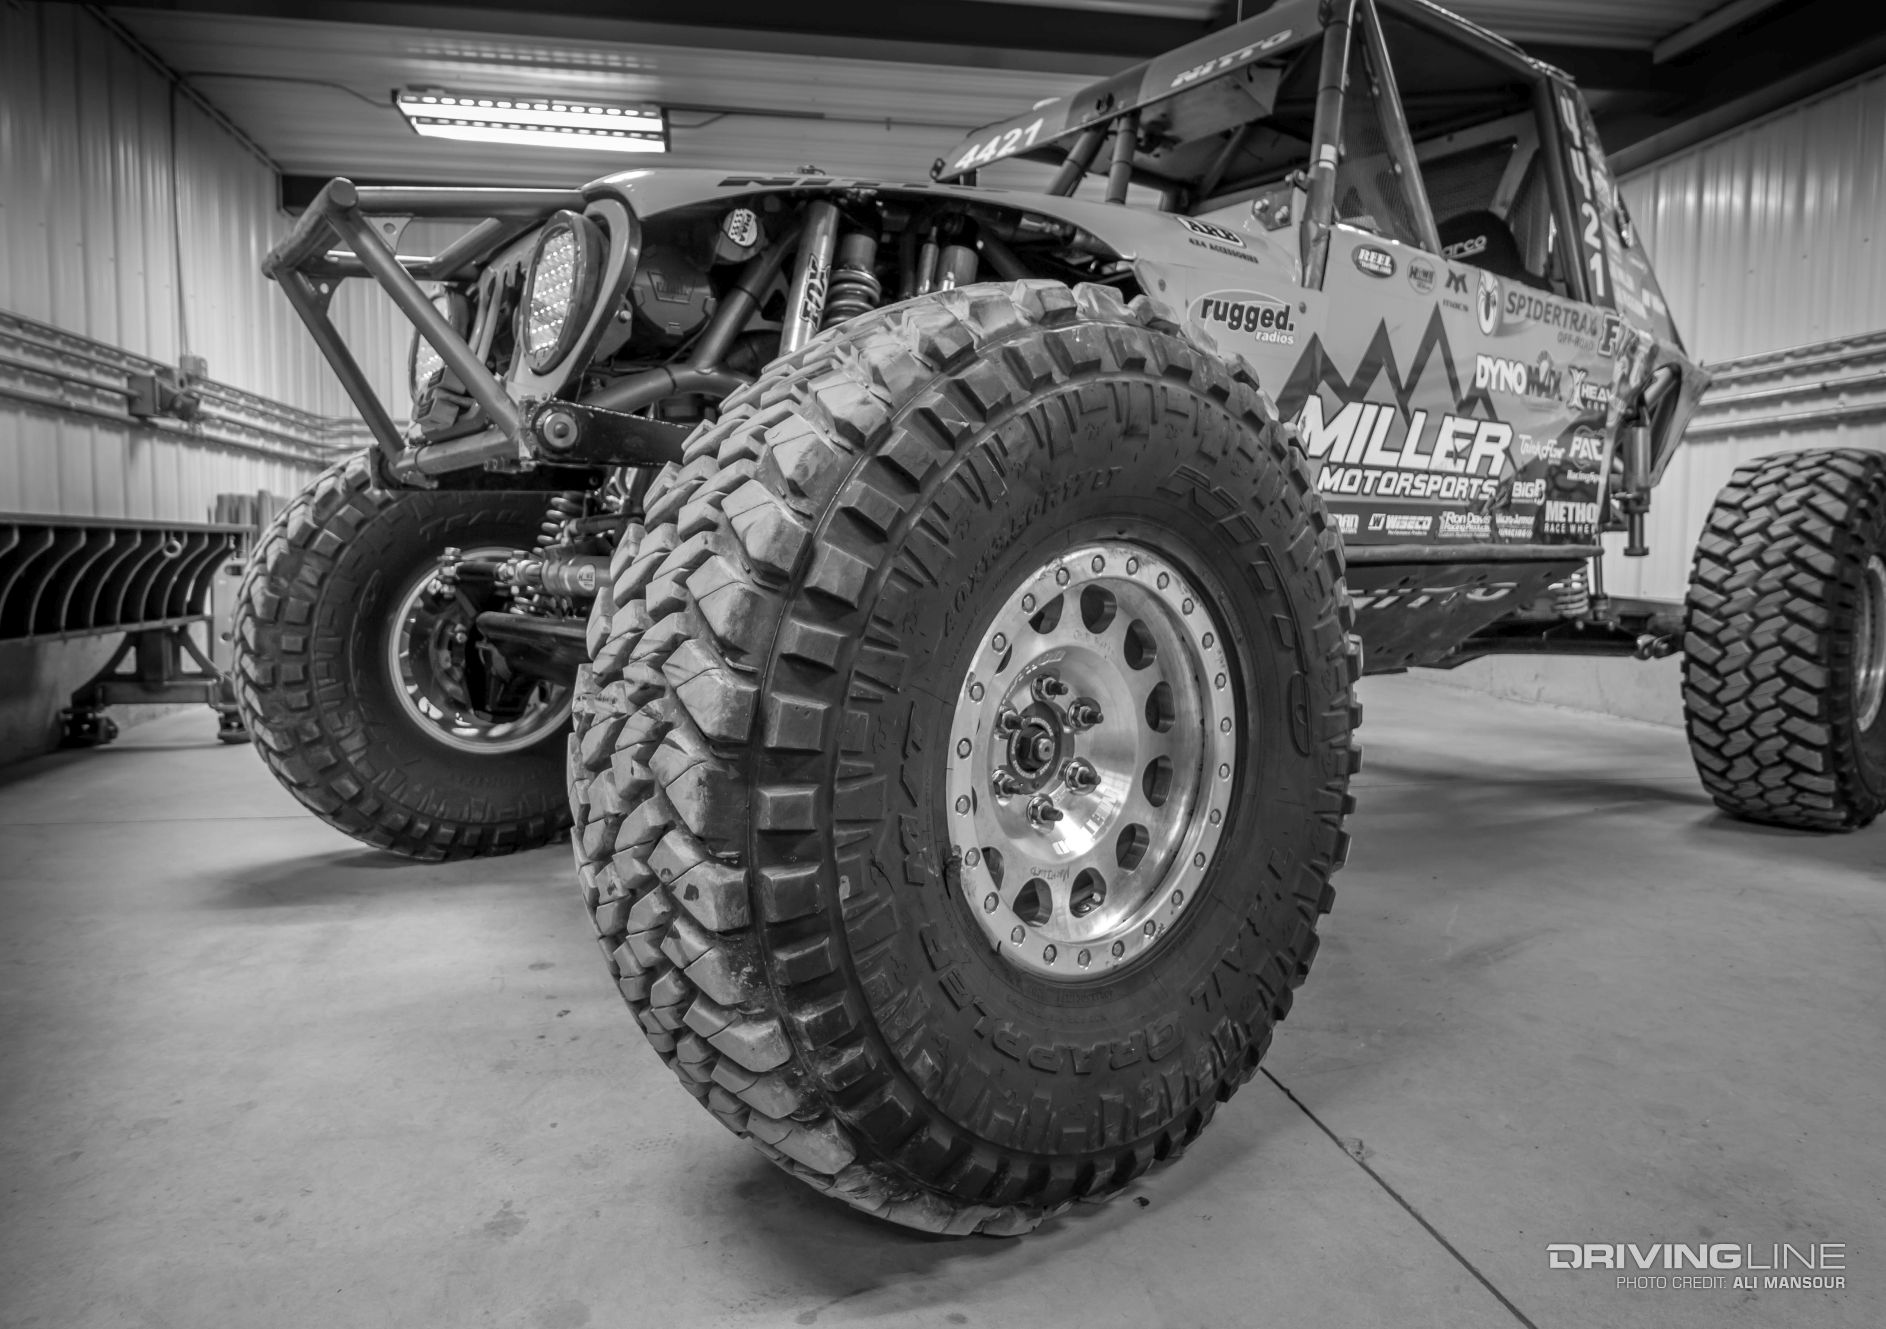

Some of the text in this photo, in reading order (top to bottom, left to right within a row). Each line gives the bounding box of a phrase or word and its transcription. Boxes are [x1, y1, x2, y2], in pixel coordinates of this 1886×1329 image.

[1170, 28, 1293, 88] NITTO
[954, 117, 1044, 169] 4421
[1185, 219, 1241, 245] ARB
[1358, 247, 1393, 268] REEL
[1441, 235, 1487, 260] arco
[800, 253, 831, 330] FOX
[1505, 290, 1599, 337] SPIDERTRAX
[1255, 331, 1295, 345] radios
[1297, 394, 1513, 476] MILLER
[1317, 465, 1499, 501] MOTORSPORTS
[1444, 510, 1492, 524] Ron Davis
[1545, 500, 1599, 523] METHO
[1544, 523, 1566, 534] RACE
